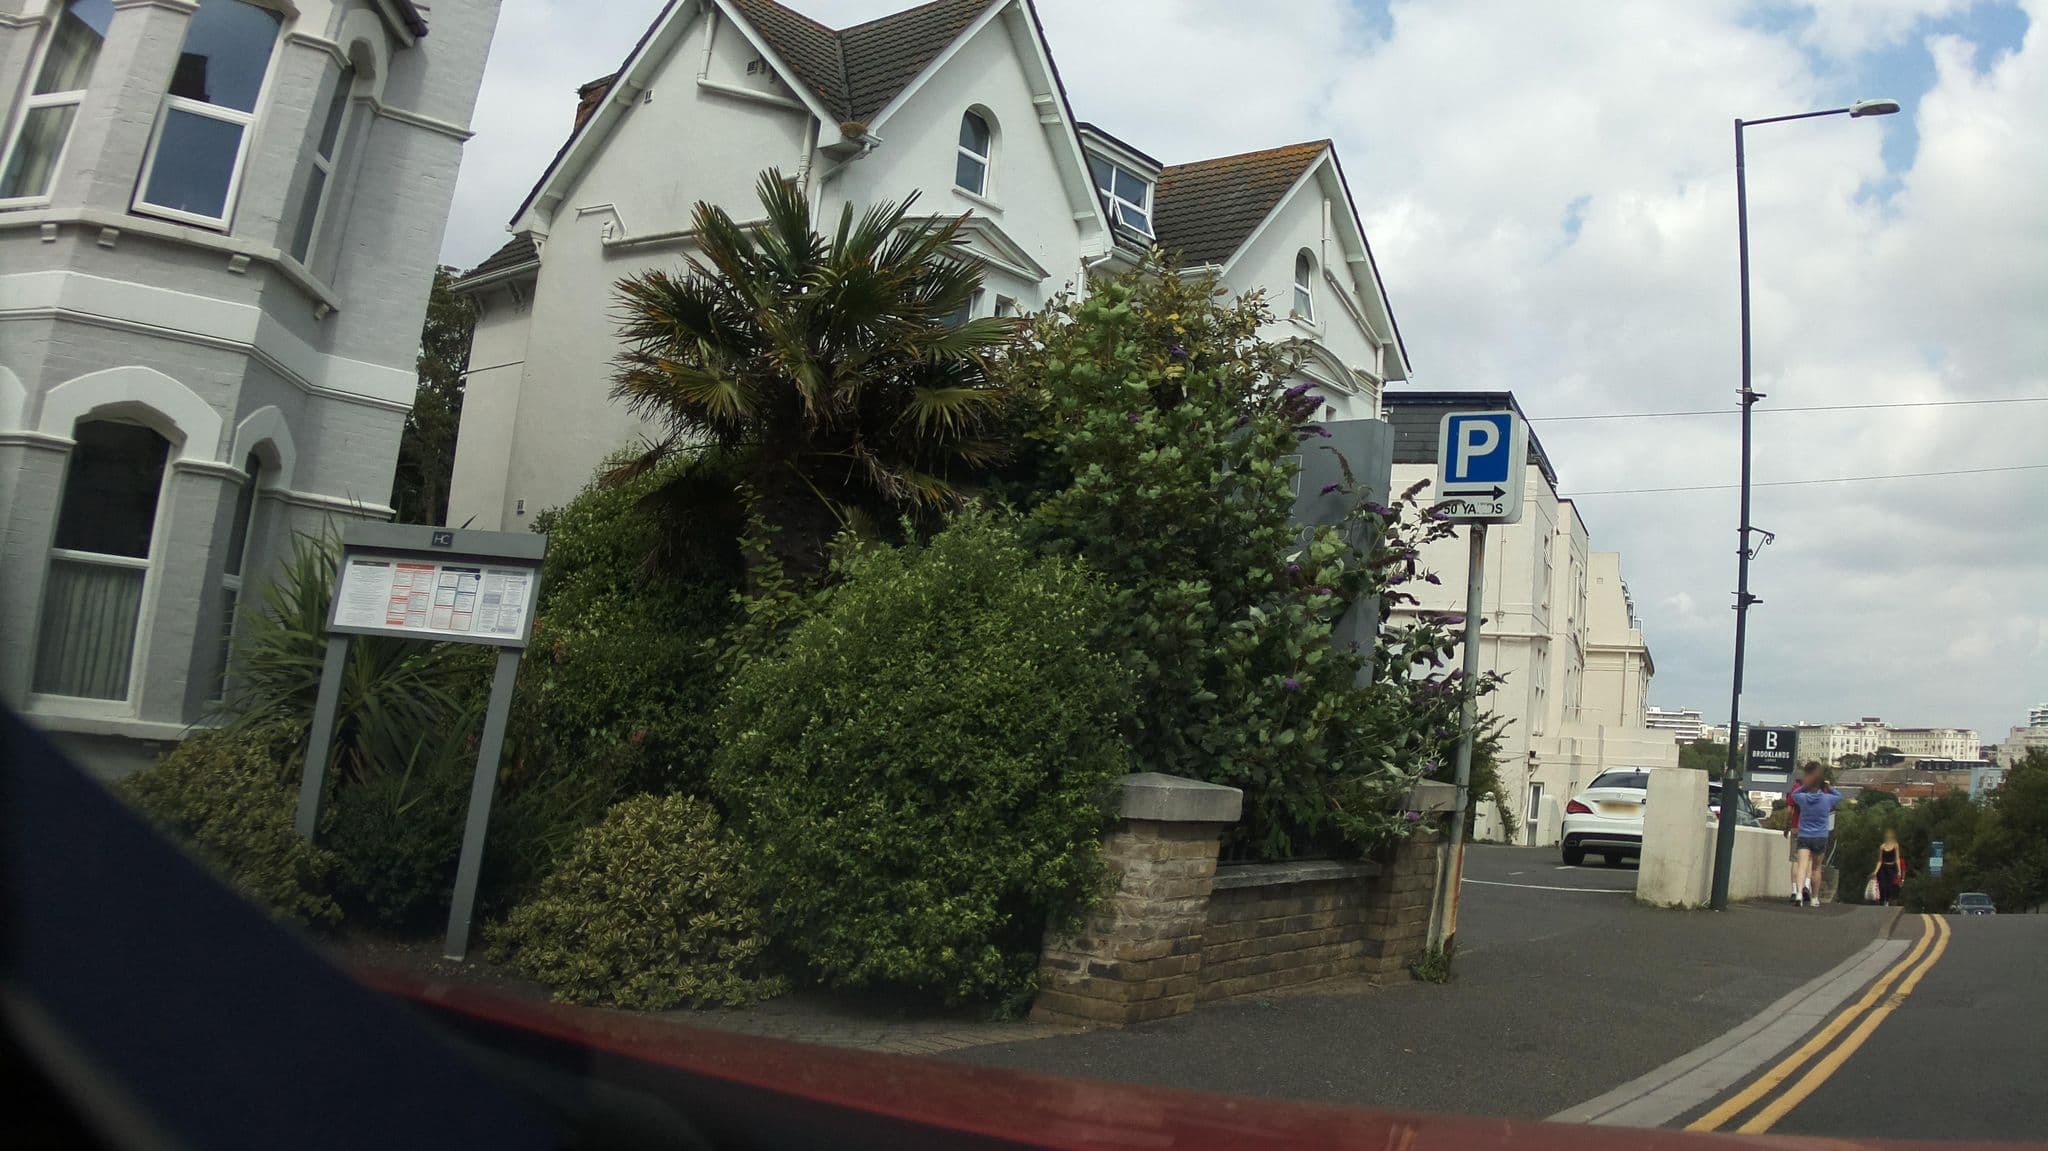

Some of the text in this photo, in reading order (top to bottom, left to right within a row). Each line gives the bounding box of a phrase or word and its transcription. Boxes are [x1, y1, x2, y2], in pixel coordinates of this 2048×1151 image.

[1456, 421, 1500, 478] P
[1444, 503, 1503, 515] 50 YAS
[1766, 731, 1778, 750] B
[1752, 750, 1790, 759] BROOKLANDS
